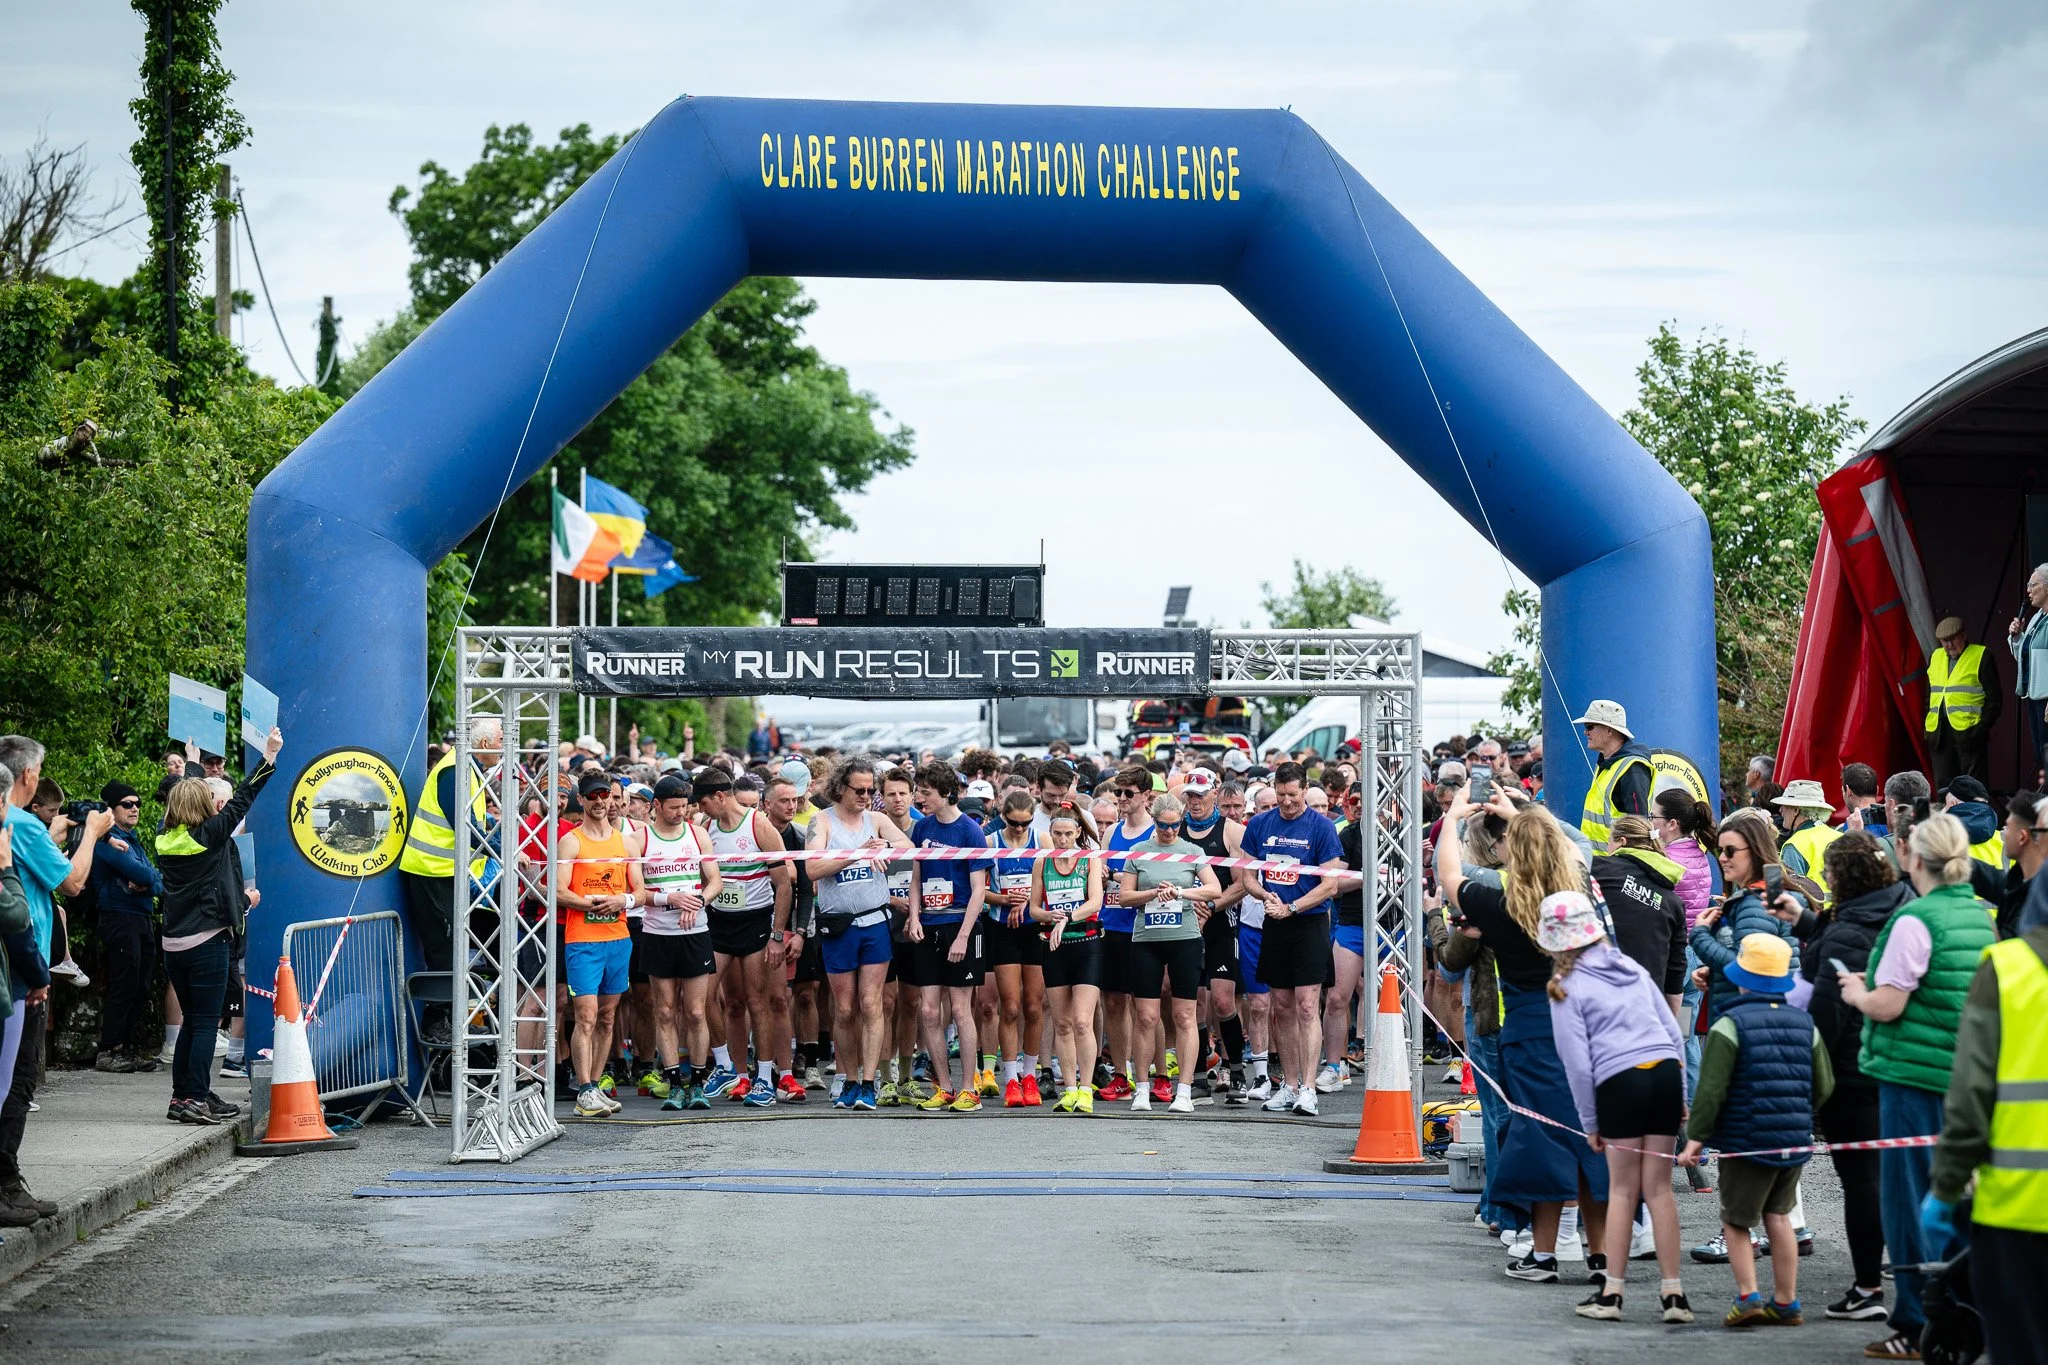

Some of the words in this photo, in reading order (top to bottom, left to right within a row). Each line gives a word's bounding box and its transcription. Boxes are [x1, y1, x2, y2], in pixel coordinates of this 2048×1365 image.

[760, 132, 838, 189] CLARE
[849, 136, 945, 193] BURREN
[956, 140, 1085, 198] MARATHON
[1097, 143, 1241, 201] CHALLENGE
[586, 651, 686, 676] RUNNER
[703, 650, 731, 664] MY
[734, 650, 825, 678] RUN
[834, 650, 1040, 678] RESULTS
[1096, 651, 1196, 675] RUNNER
[310, 844, 359, 875] Walking
[362, 853, 388, 871] Club
[840, 868, 868, 881] 1475
[1048, 880, 1071, 890] MAYO
[1072, 878, 1084, 888] AC
[1623, 878, 1651, 899] RUN
[924, 895, 950, 907] 5354
[1149, 913, 1176, 925] 1373
